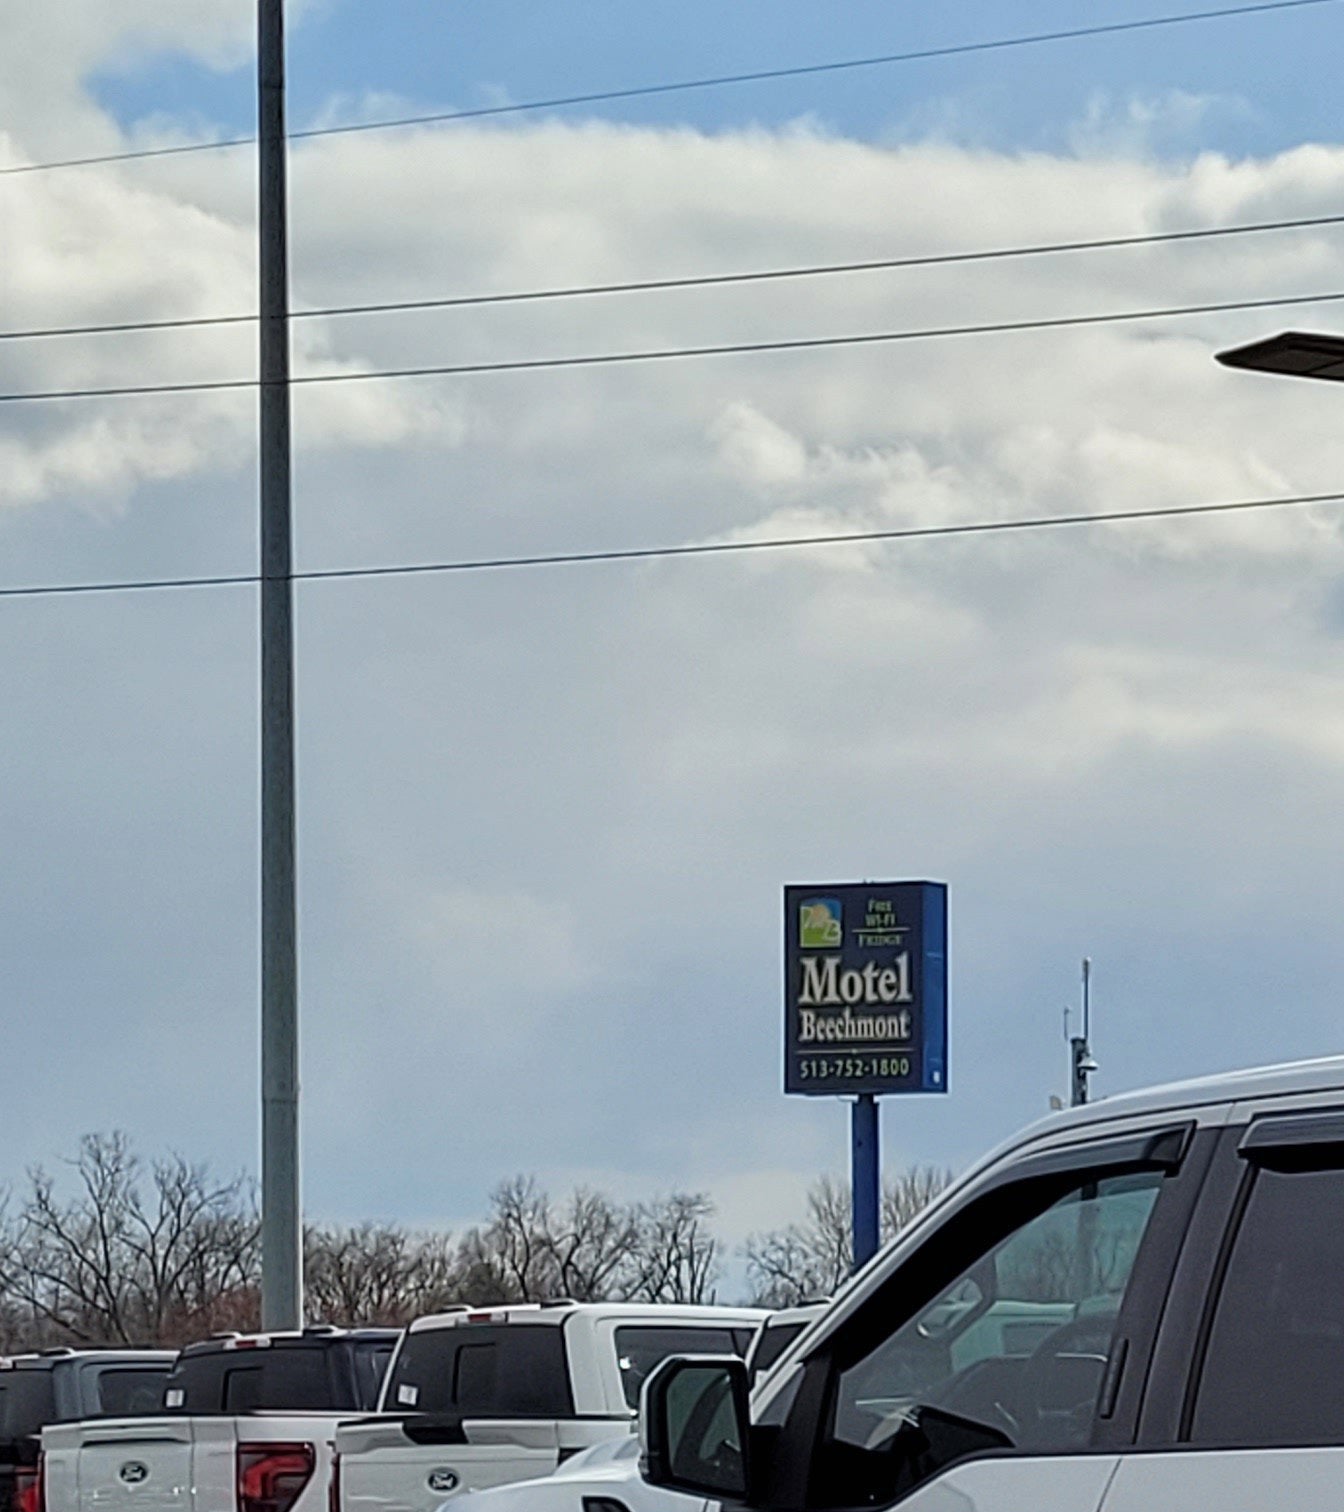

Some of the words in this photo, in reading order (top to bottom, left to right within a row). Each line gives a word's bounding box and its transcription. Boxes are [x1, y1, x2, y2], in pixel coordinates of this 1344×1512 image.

[799, 952, 913, 1004] Motel
[799, 1008, 910, 1041] Beechmont
[800, 1058, 910, 1079] 513-752-1800
